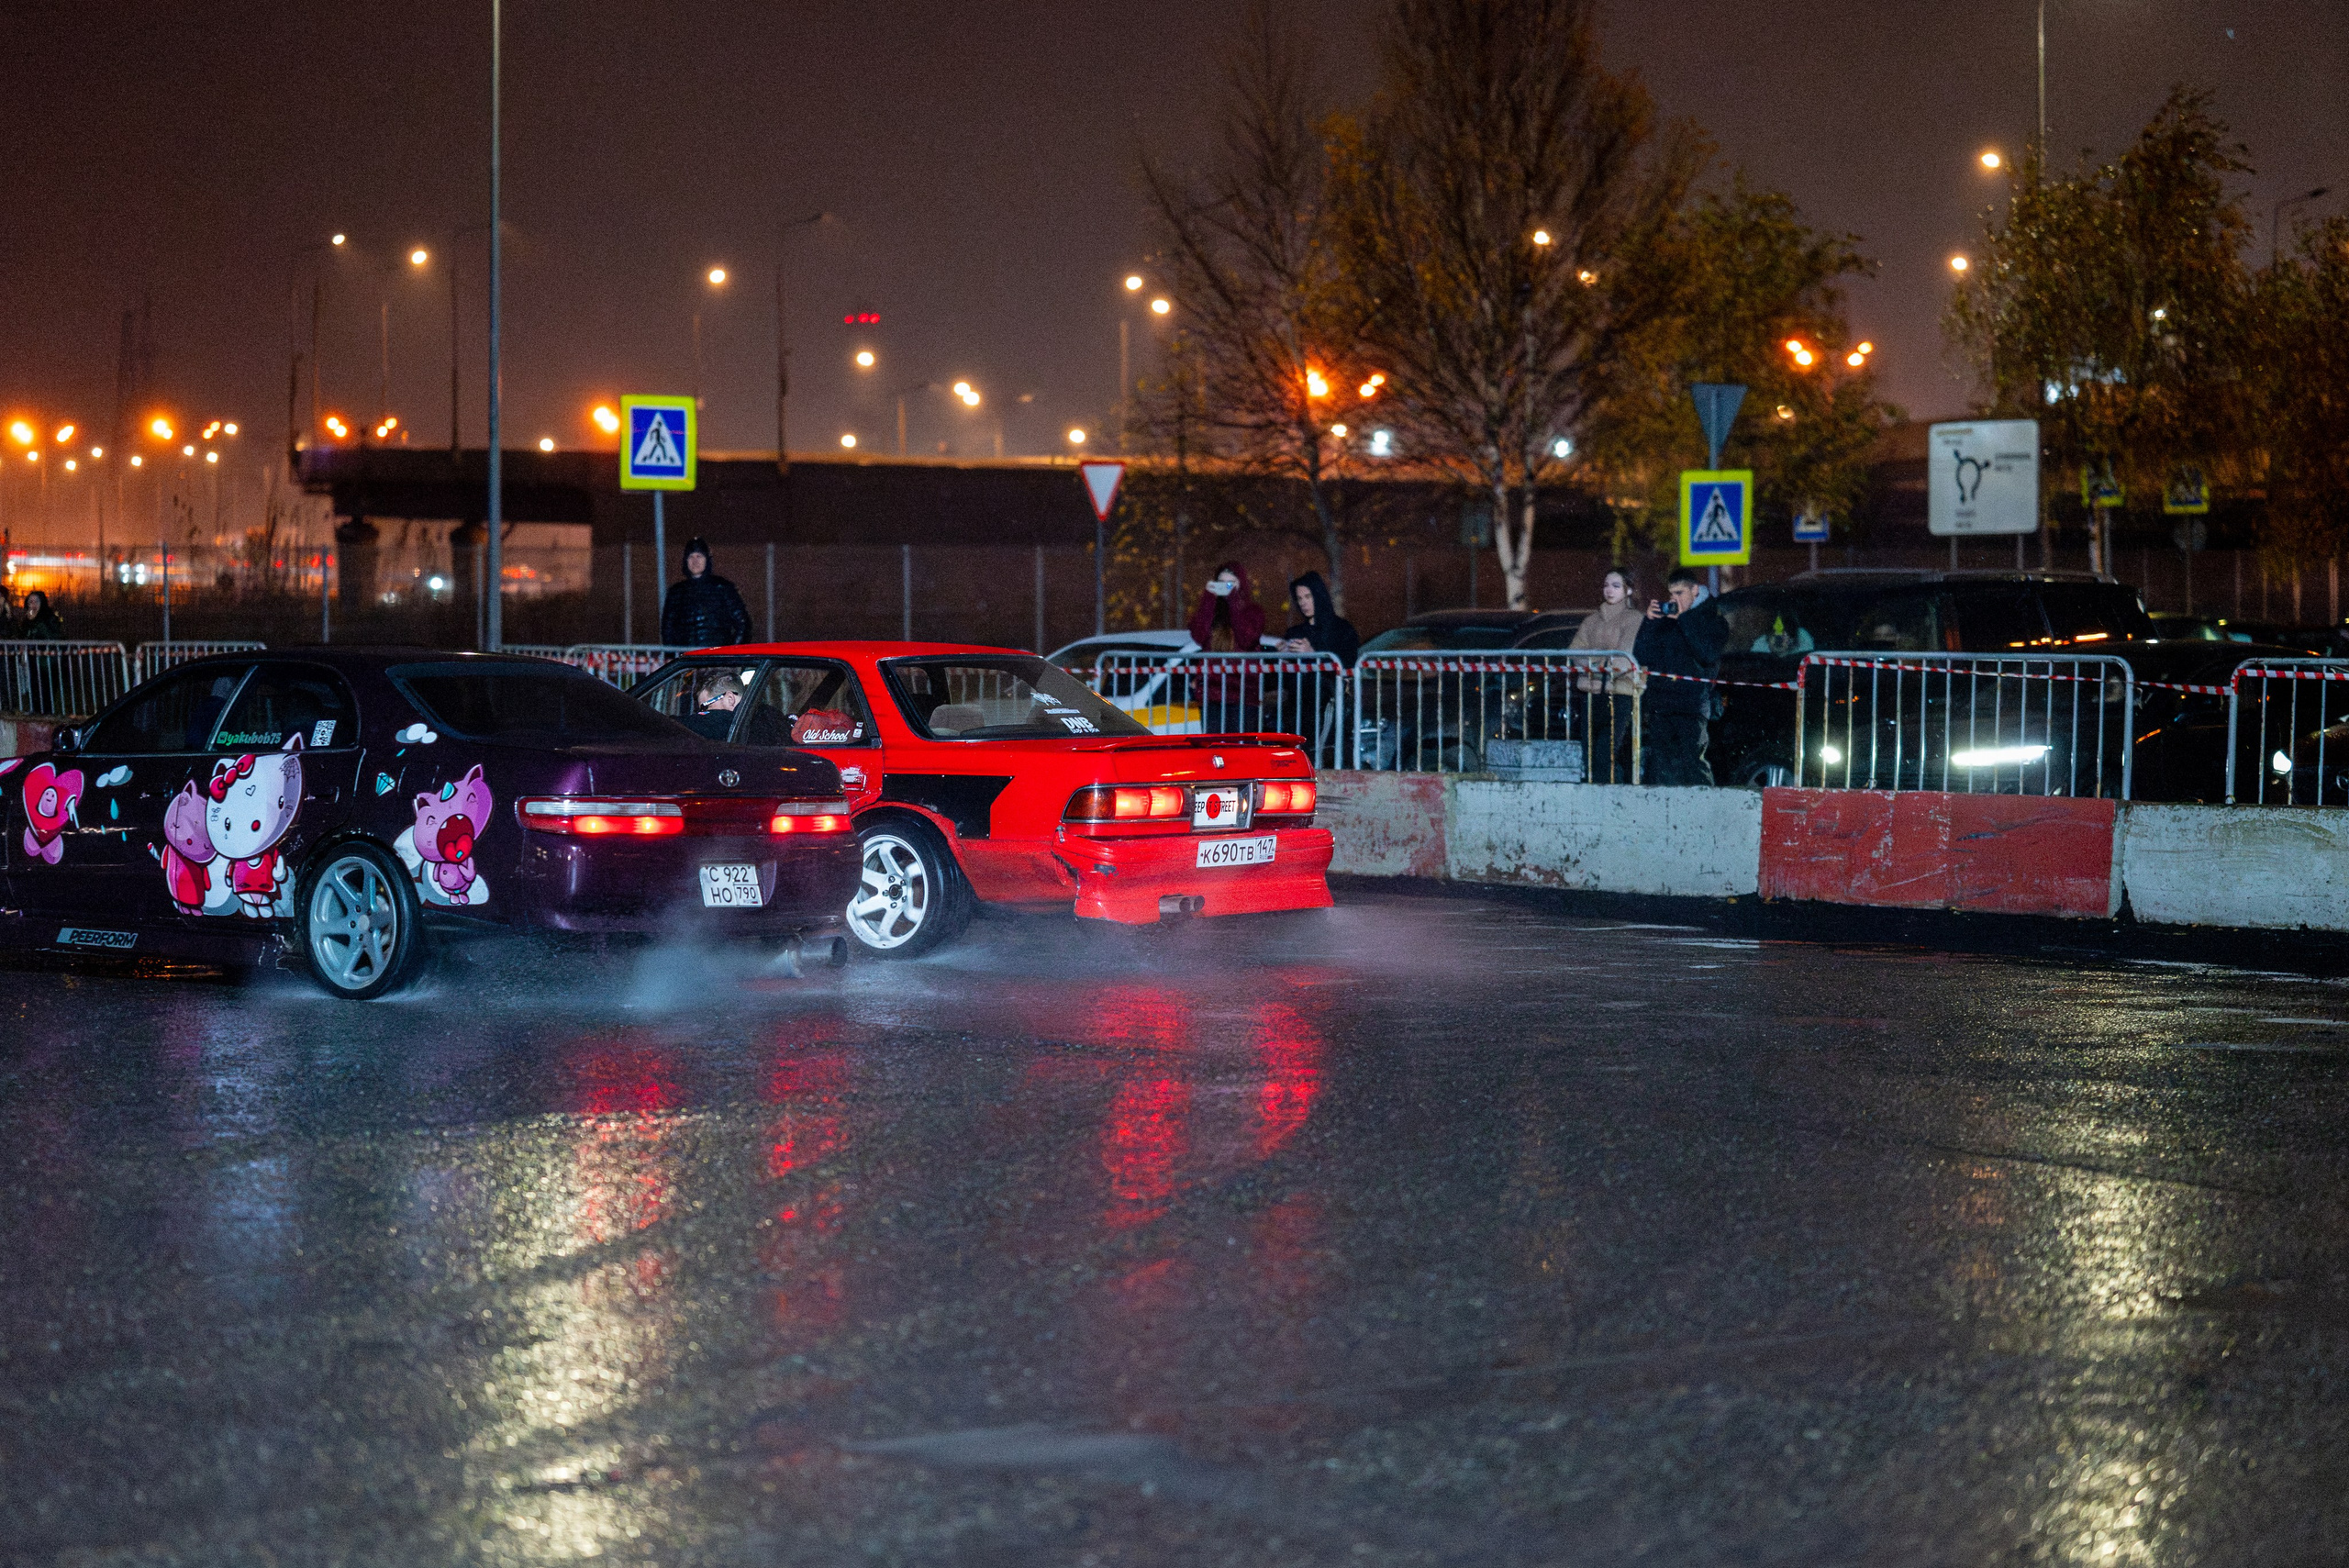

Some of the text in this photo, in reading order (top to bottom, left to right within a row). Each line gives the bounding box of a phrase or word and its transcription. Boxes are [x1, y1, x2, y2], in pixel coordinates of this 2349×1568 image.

[1061, 717, 1094, 729] DNB
[803, 729, 850, 742] Old School
[1195, 801, 1206, 814] EEP
[1214, 800, 1236, 813] STREET
[1203, 839, 1274, 863] К690ТВ 147
[709, 866, 750, 883] С 922
[710, 886, 757, 903] НО 790
[69, 929, 138, 948] PEERFORM
